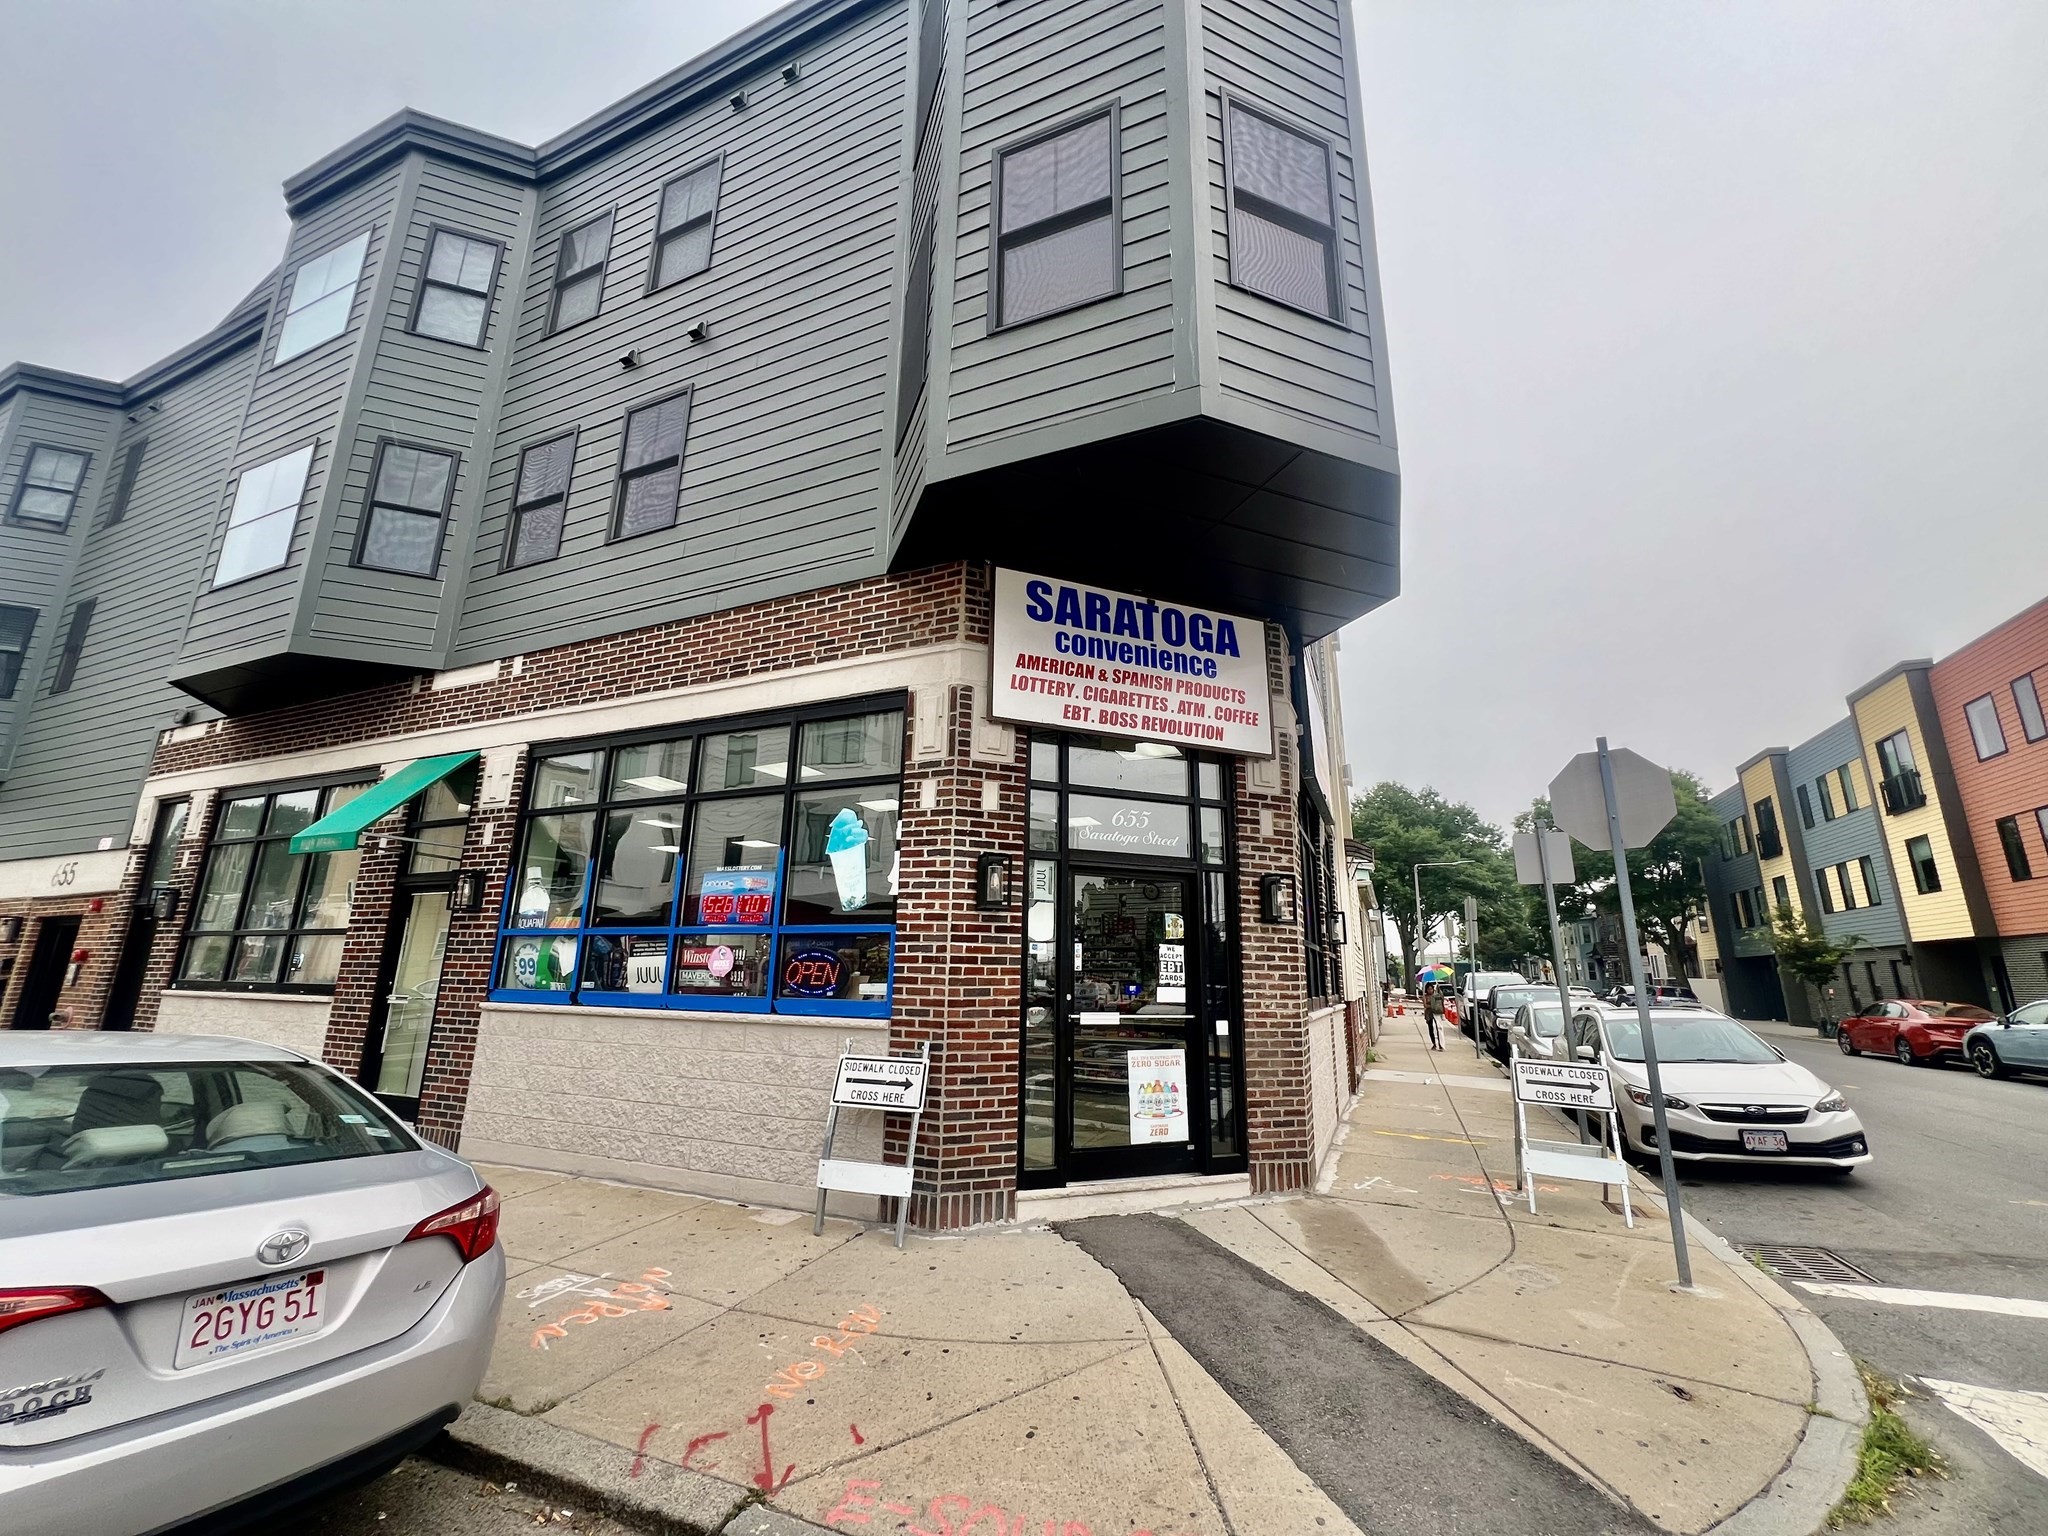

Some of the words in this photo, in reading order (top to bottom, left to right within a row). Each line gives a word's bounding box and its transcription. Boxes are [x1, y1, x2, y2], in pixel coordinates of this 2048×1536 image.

[1026, 580, 1240, 658] SARATOGA
[1055, 631, 1217, 679] convenience
[1015, 653, 1095, 680] AMERICAN
[1098, 668, 1109, 681] &
[1112, 670, 1173, 693] SPANISH
[1176, 679, 1247, 705] PRODUCTS
[1099, 709, 1138, 729] BOSS
[1141, 716, 1225, 741] REVOLUTION
[1214, 705, 1259, 726] COFFEE
[1112, 808, 1152, 828] 655
[1079, 825, 1140, 846] Saratoga
[1143, 830, 1180, 847] Street
[51, 862, 79, 887] 655
[1036, 868, 1047, 891] JUUL
[683, 949, 710, 964] Winsto
[1160, 961, 1182, 973] EBT
[636, 966, 663, 983] JUUL
[785, 961, 840, 985] OPEN
[1160, 974, 1183, 982] CARDS
[844, 1062, 885, 1073] SIDEWALK
[888, 1064, 921, 1076] CLOSED
[1131, 1060, 1152, 1068] ZERO
[1154, 1059, 1181, 1067] SUGAR
[1520, 1065, 1563, 1077] SIDEWALK
[1568, 1070, 1604, 1081] CLOSED
[850, 1089, 879, 1101] CROSS
[882, 1092, 905, 1103] HERE
[1535, 1090, 1566, 1102] CROSS
[1570, 1093, 1595, 1104] HERE
[1149, 1128, 1169, 1136] ZERO
[222, 1278, 300, 1303] Massachusetts
[192, 1296, 215, 1309] JAN
[191, 1296, 276, 1349] 2GYG
[284, 1286, 318, 1323] 51
[214, 1343, 229, 1354] The
[230, 1338, 251, 1350] Spirit
[261, 1328, 293, 1341] America
[0, 1368, 107, 1401] OROLLA
[0, 1384, 92, 1419] BOCH
